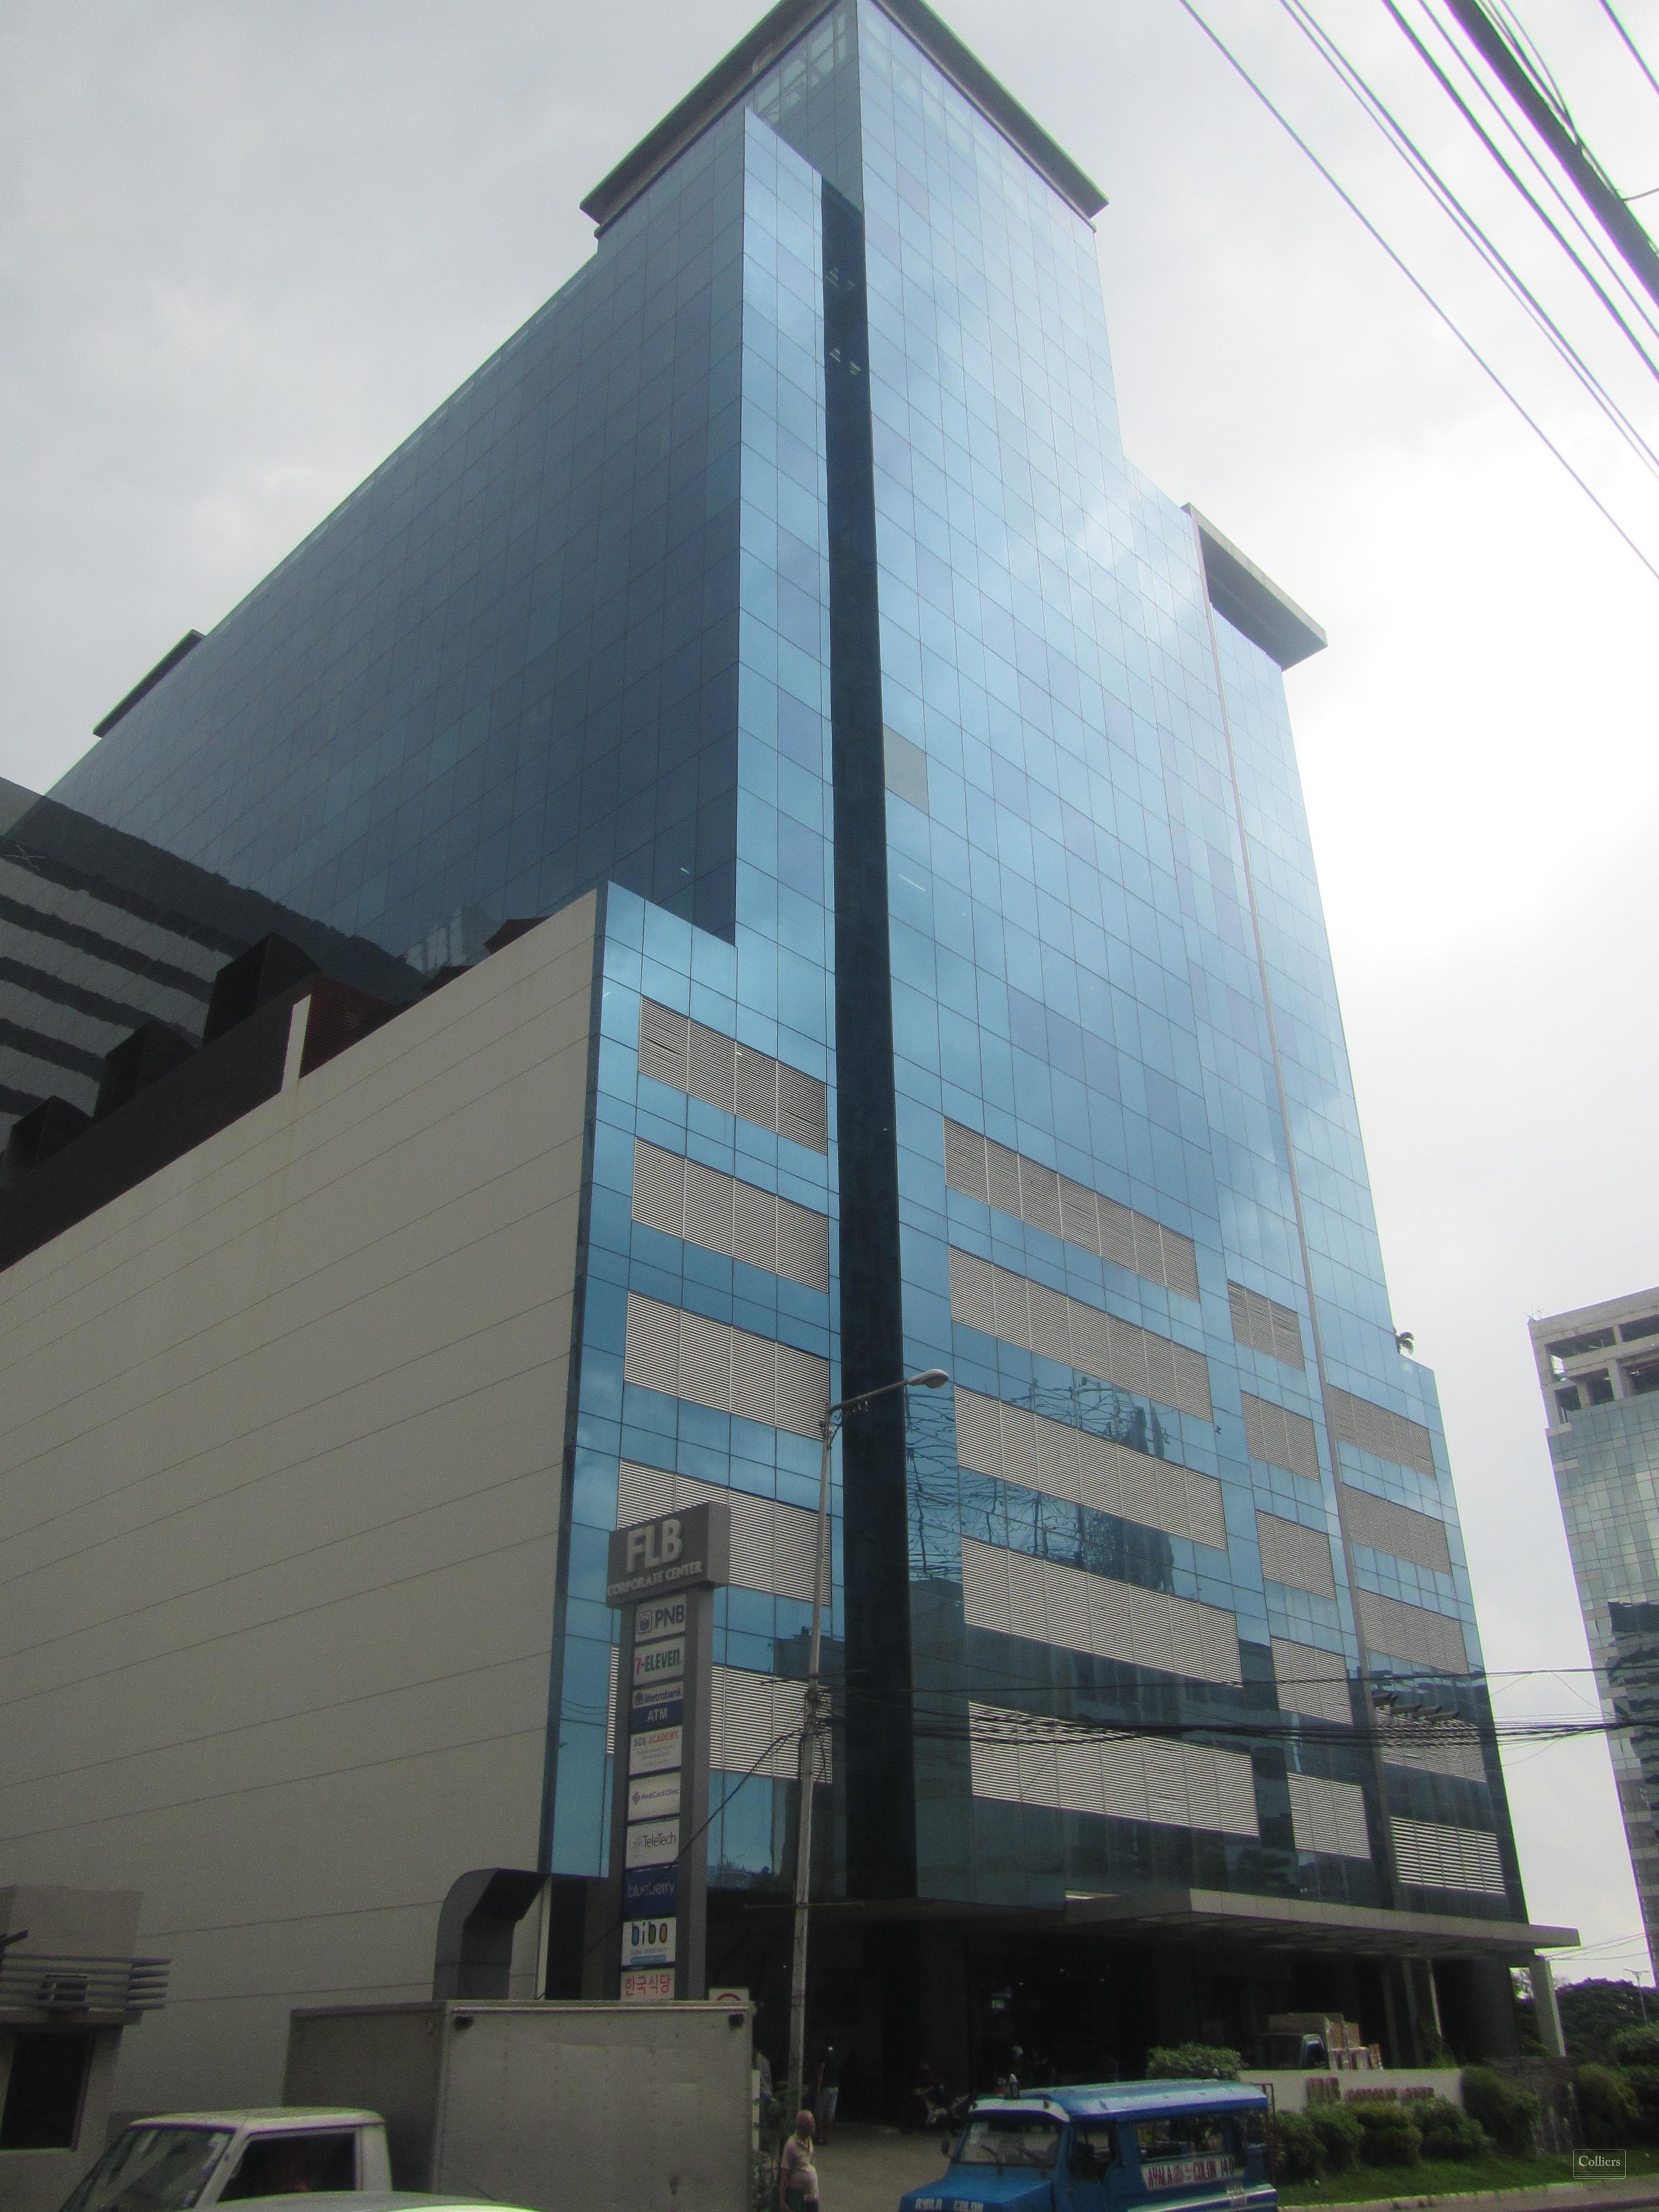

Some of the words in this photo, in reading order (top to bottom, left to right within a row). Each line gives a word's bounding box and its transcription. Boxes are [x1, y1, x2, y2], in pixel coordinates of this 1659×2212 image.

[627, 1519, 683, 1574] FLB
[608, 1571, 664, 1597] CORPORATE
[665, 1561, 703, 1581] CENTER
[655, 1604, 685, 1629] PNB
[645, 1687, 681, 1703] Metrobank
[646, 1707, 667, 1723] ATM
[648, 1729, 679, 1744] ACADEMY
[641, 1790, 665, 1799] MediCard
[643, 1831, 676, 1848] TeleTech
[632, 1921, 667, 1946] bibo
[625, 1974, 671, 1996] 한국식당
